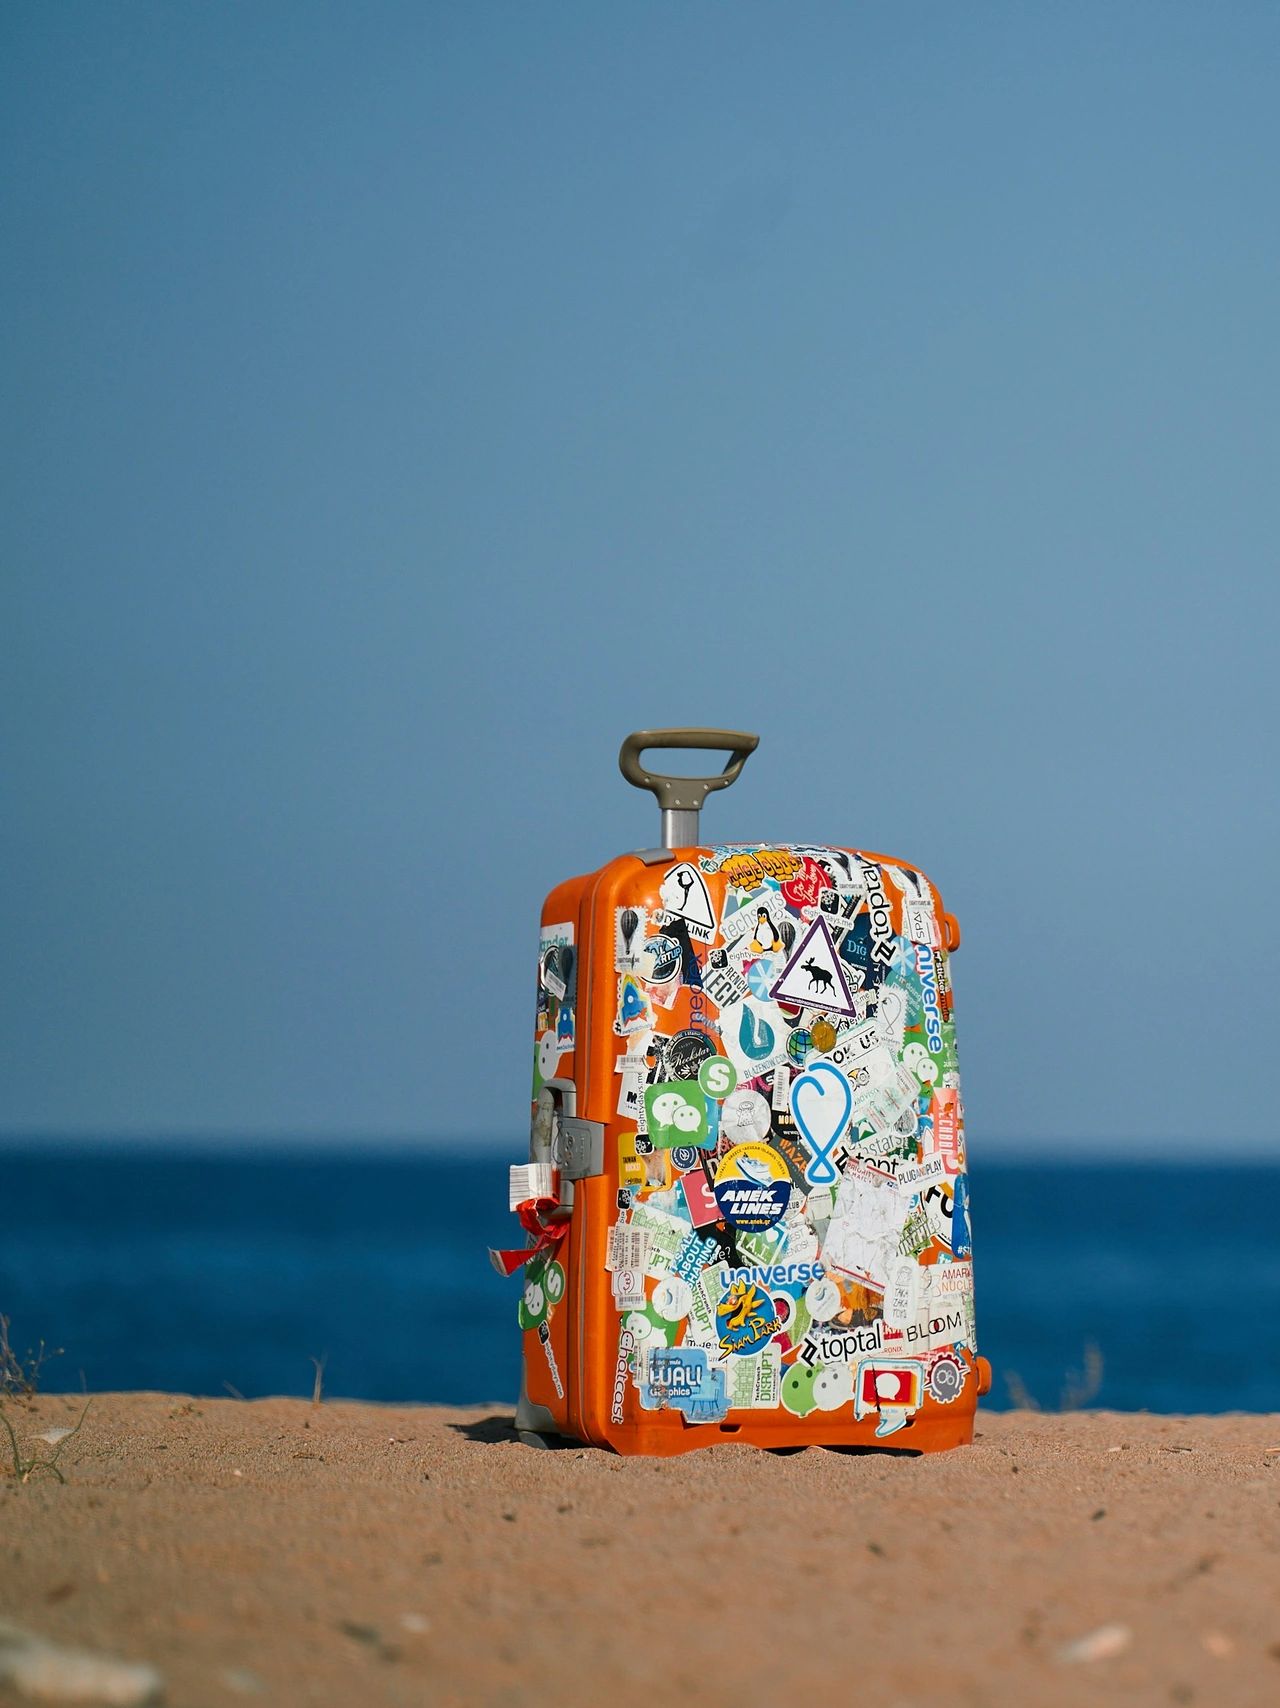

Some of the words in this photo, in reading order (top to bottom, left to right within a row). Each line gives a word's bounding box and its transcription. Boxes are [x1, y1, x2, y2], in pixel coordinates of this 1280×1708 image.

[728, 862, 763, 883] RAGE
[861, 860, 890, 938] toptal
[804, 909, 853, 928] eighdays.me
[725, 964, 749, 994] RENCH
[918, 944, 942, 1052] niverse
[720, 1190, 777, 1202] ANEK
[730, 1203, 784, 1215] LINES
[678, 1237, 705, 1280] ABOUT
[686, 1237, 718, 1289] SHARING
[721, 1262, 825, 1289] universe
[941, 1280, 972, 1292] NUCLE
[697, 1281, 712, 1315] TechCrunch
[820, 1323, 881, 1362] toptal
[907, 1312, 962, 1343] BLOOM
[760, 1351, 773, 1402] DISRUPT
